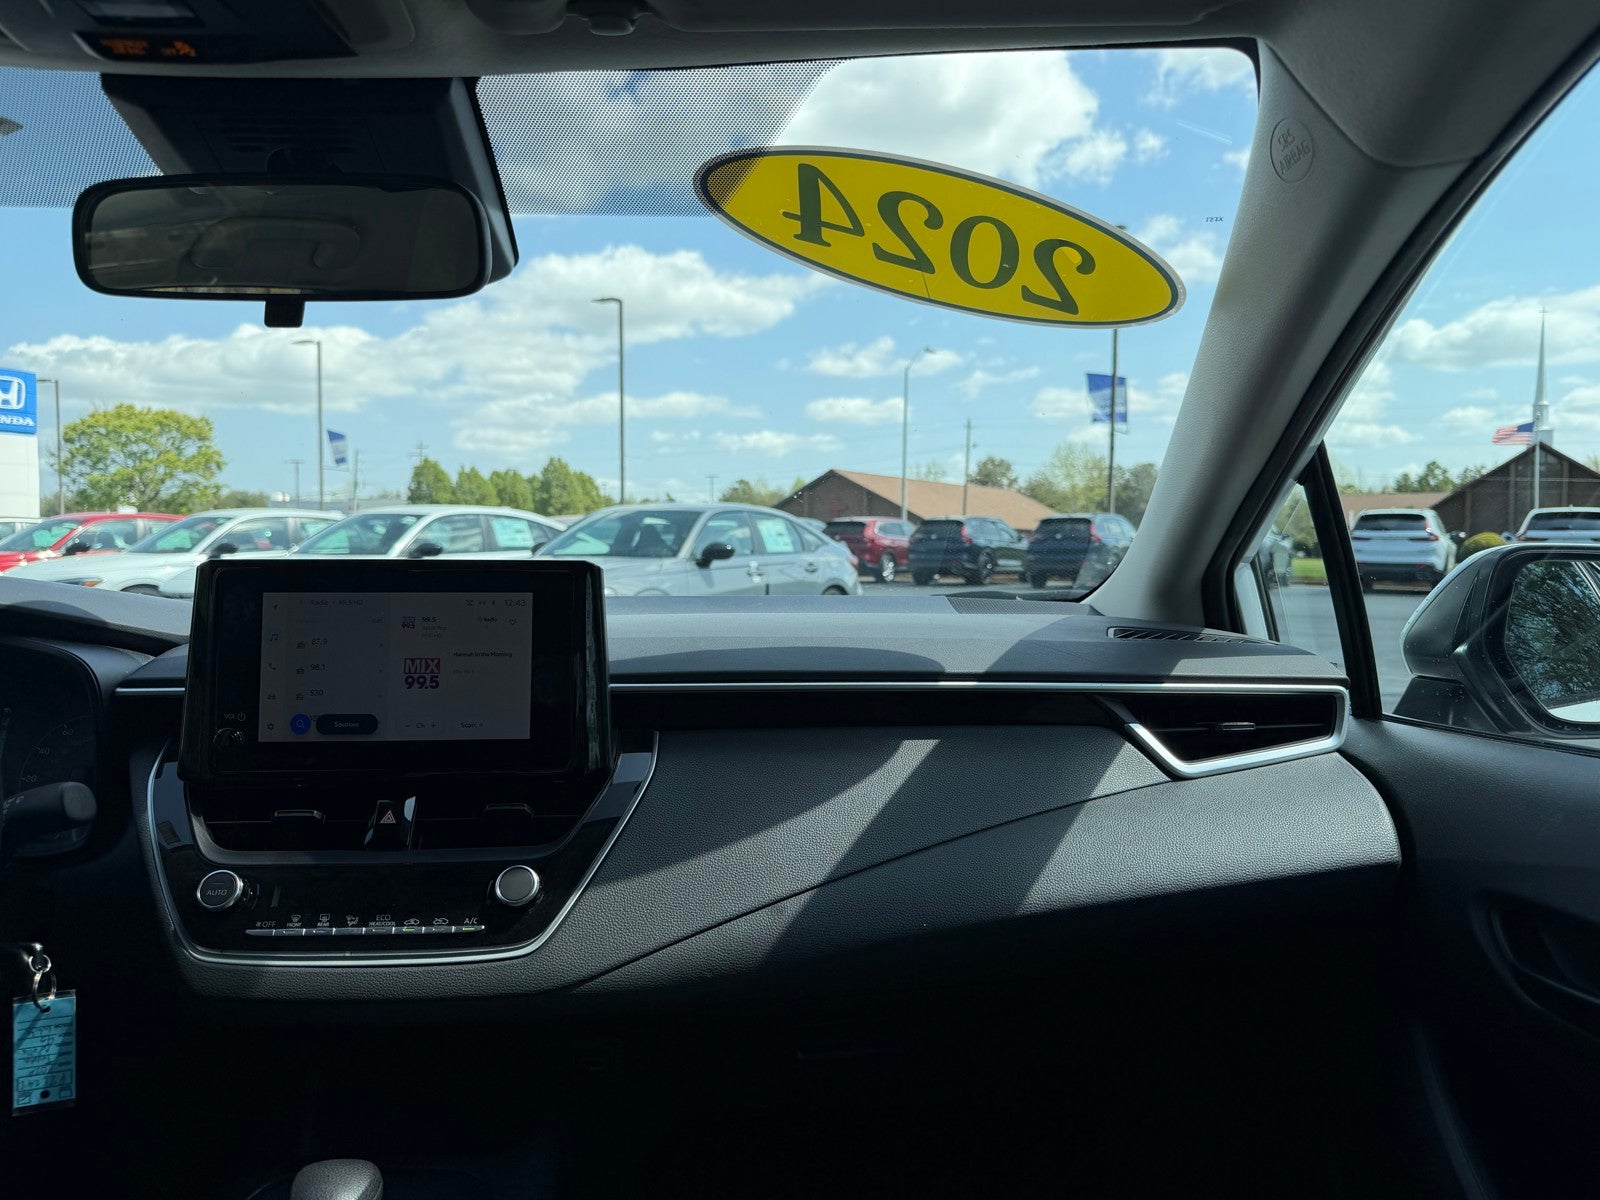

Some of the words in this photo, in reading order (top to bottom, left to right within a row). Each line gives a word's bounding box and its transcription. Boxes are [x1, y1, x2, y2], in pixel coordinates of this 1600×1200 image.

[1279, 140, 1311, 174] AIRBAG
[504, 599, 526, 607] 12:43
[404, 658, 440, 674] MIX
[405, 675, 440, 690] 99.5
[310, 689, 324, 697] 530
[262, 920, 277, 928] OFF
[463, 917, 478, 925] A/C
